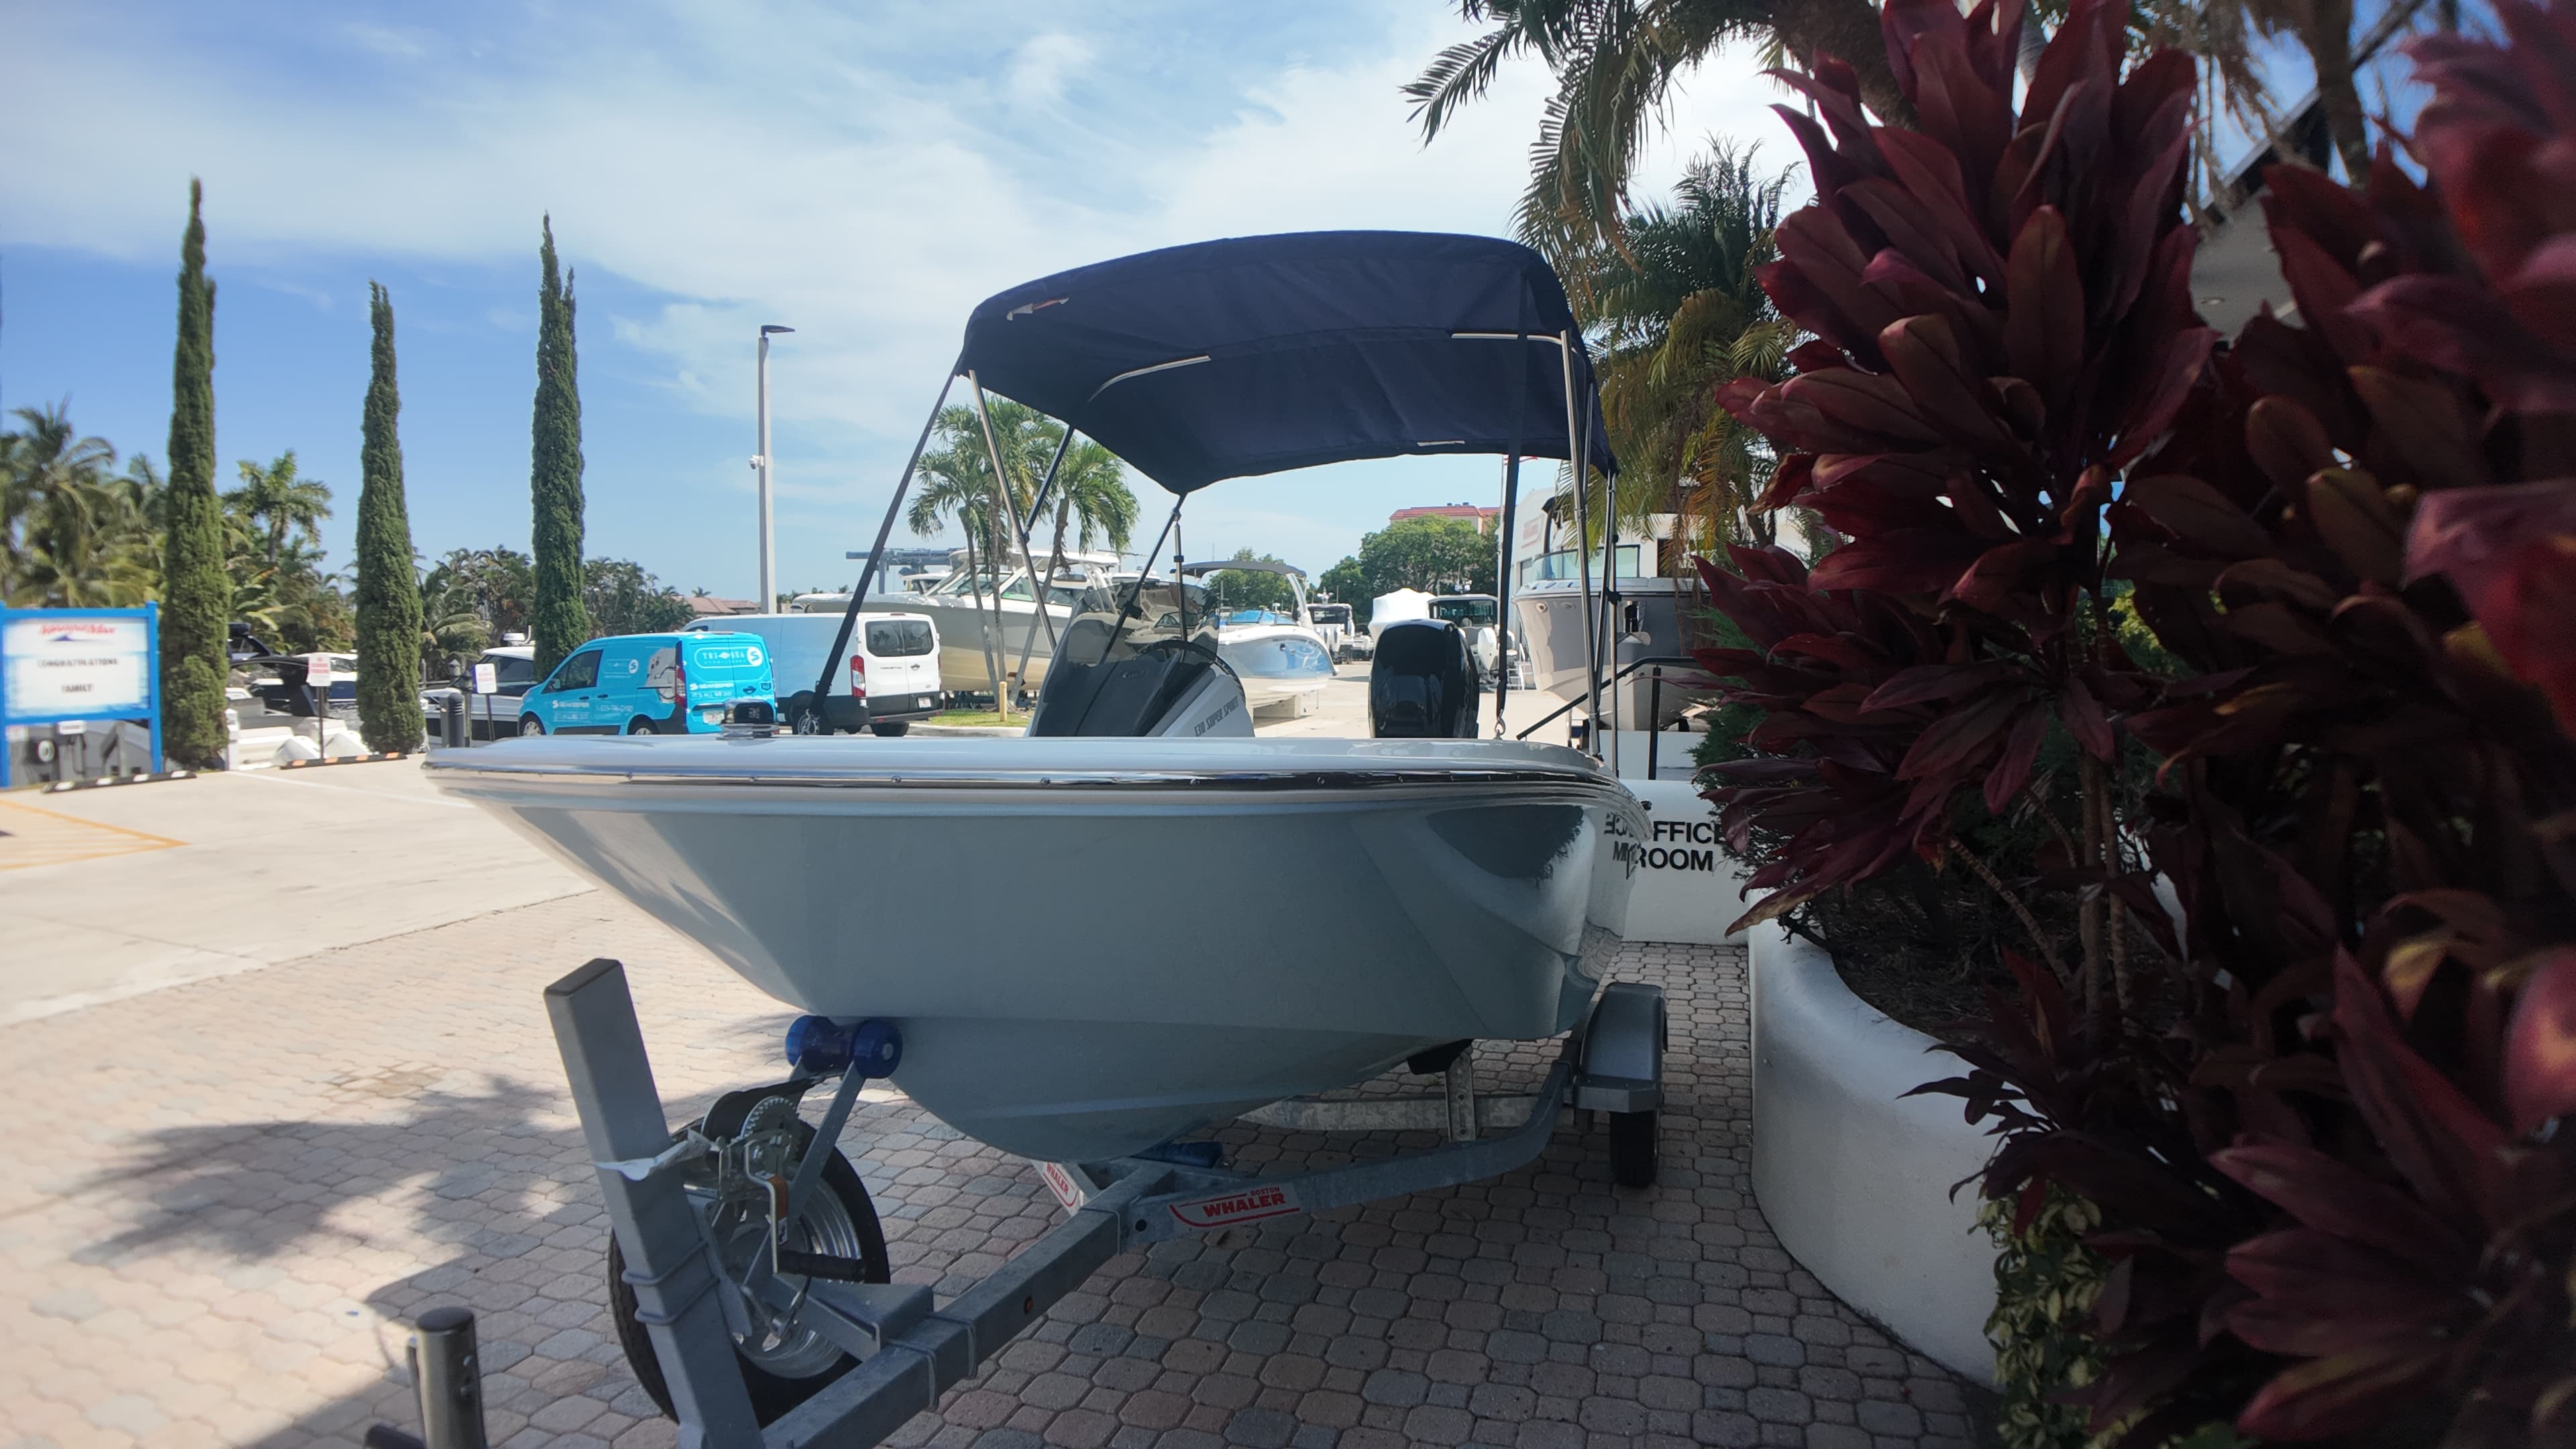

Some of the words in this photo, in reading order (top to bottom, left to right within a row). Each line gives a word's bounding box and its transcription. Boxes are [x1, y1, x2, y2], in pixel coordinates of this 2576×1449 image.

[1194, 720, 1205, 737] 130
[1205, 708, 1223, 730] SUPER
[1223, 695, 1238, 717] SPORT
[1653, 820, 1723, 845] FFICE
[1046, 1161, 1069, 1195] WHALER
[1250, 1186, 1280, 1196] BOSTON
[1202, 1193, 1286, 1218] WHALER
